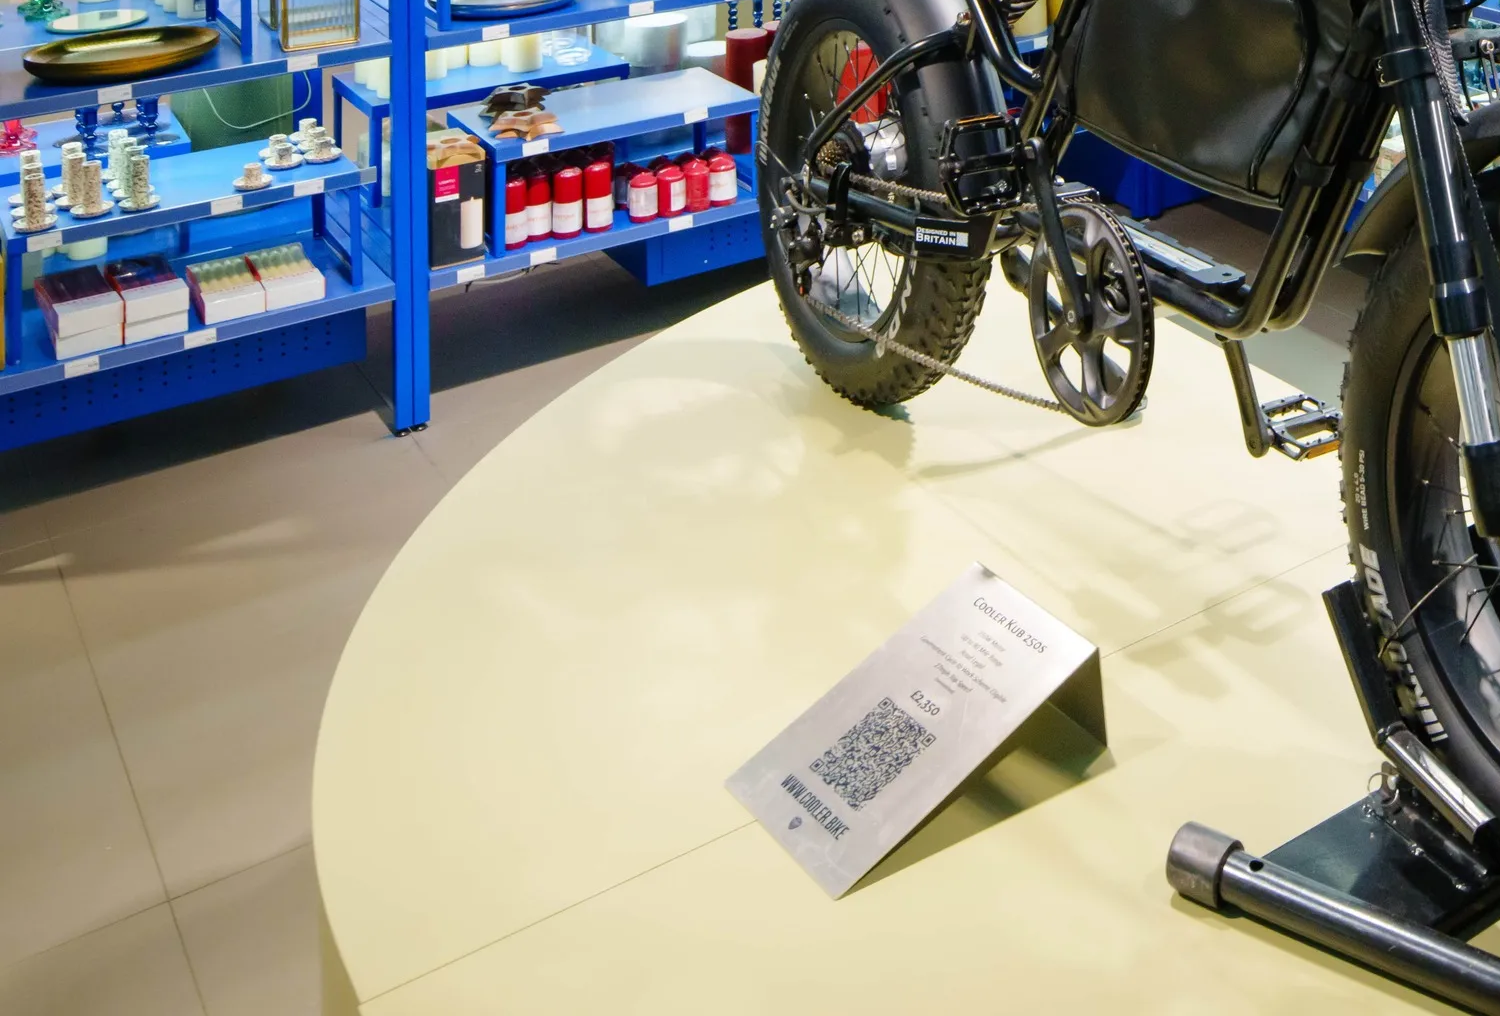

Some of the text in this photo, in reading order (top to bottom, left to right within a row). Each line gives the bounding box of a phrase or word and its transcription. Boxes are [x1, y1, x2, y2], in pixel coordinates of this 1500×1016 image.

[1362, 510, 1370, 531] WIRE
[910, 690, 941, 716] £2,350
[781, 773, 850, 840] WWW.COOLER.BIKE
